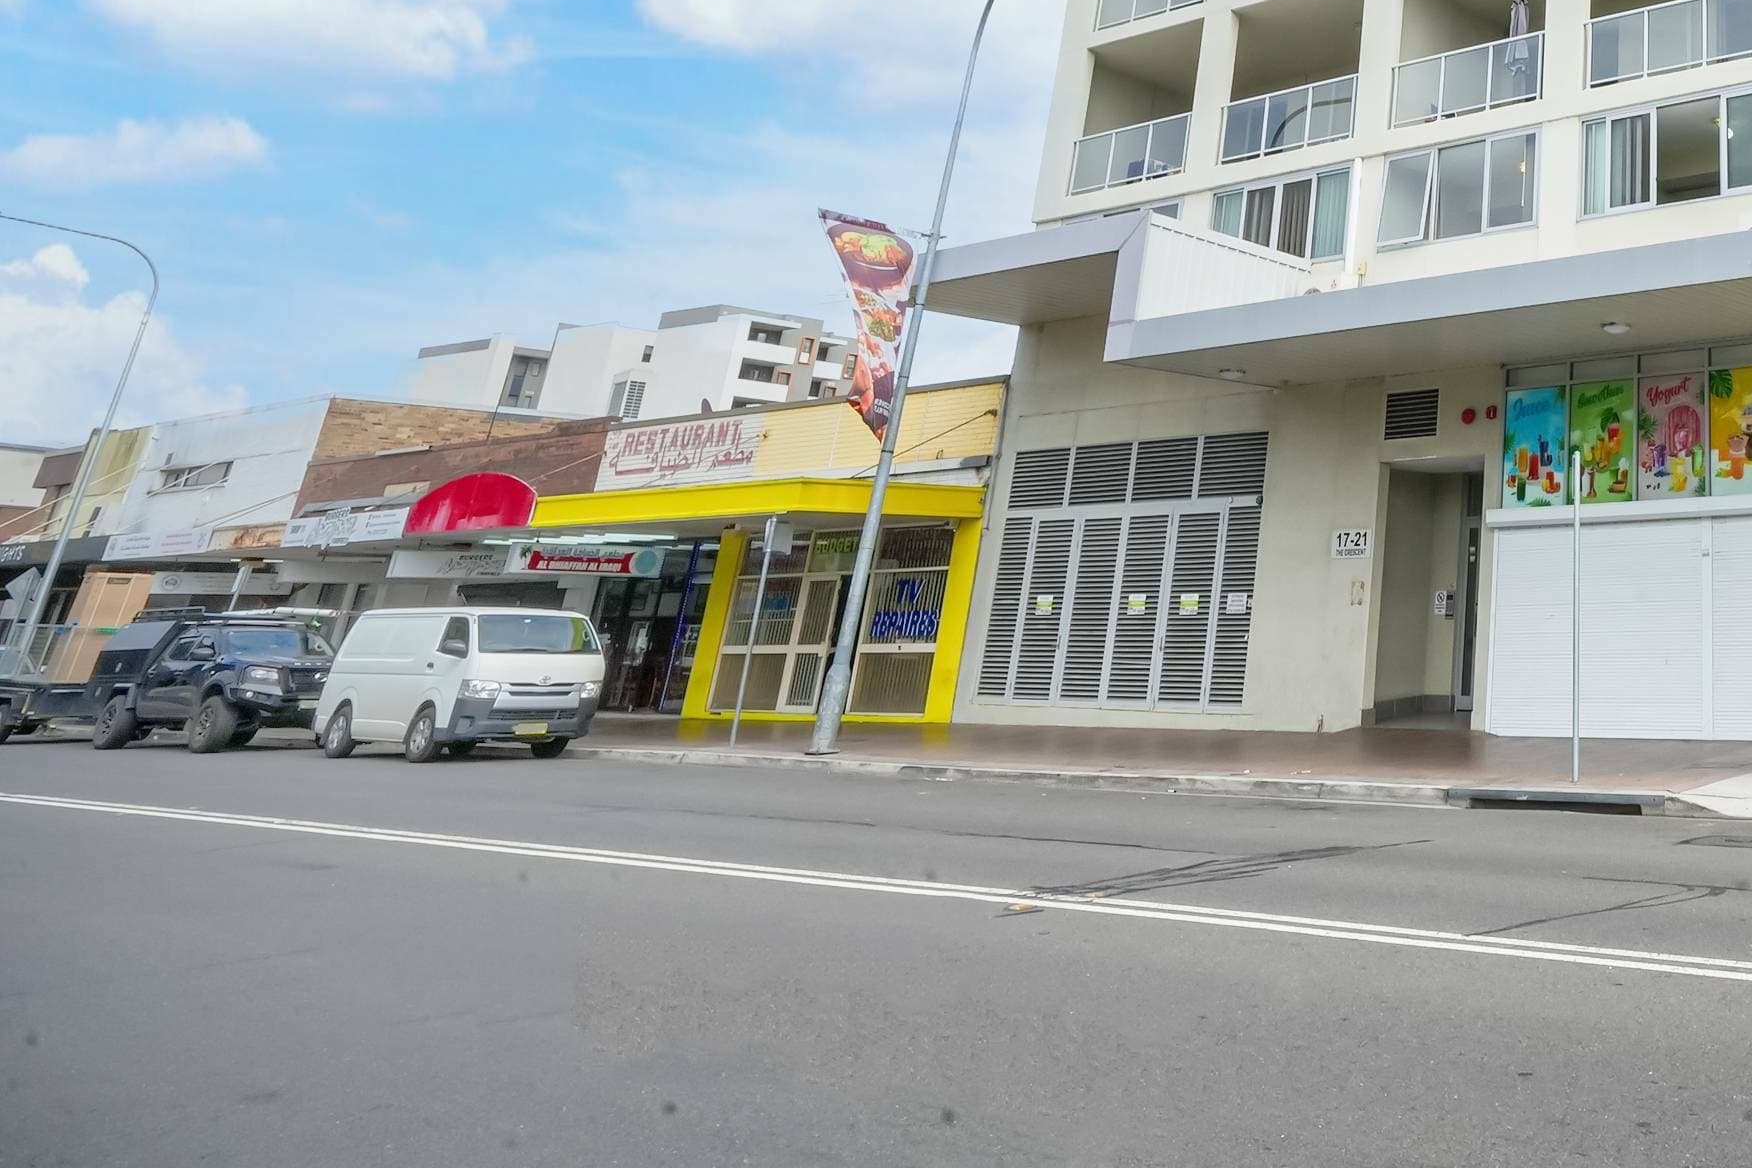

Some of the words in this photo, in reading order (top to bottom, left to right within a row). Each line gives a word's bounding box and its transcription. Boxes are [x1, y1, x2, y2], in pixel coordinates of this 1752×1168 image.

[1647, 376, 1692, 407] Yogurt
[621, 420, 743, 458] RESTAURANT
[1336, 531, 1367, 547] 17-21
[1336, 548, 1344, 556] THE
[1344, 548, 1367, 556] CRESCENT
[896, 578, 927, 606] TV
[871, 609, 939, 639] REPAIRES
